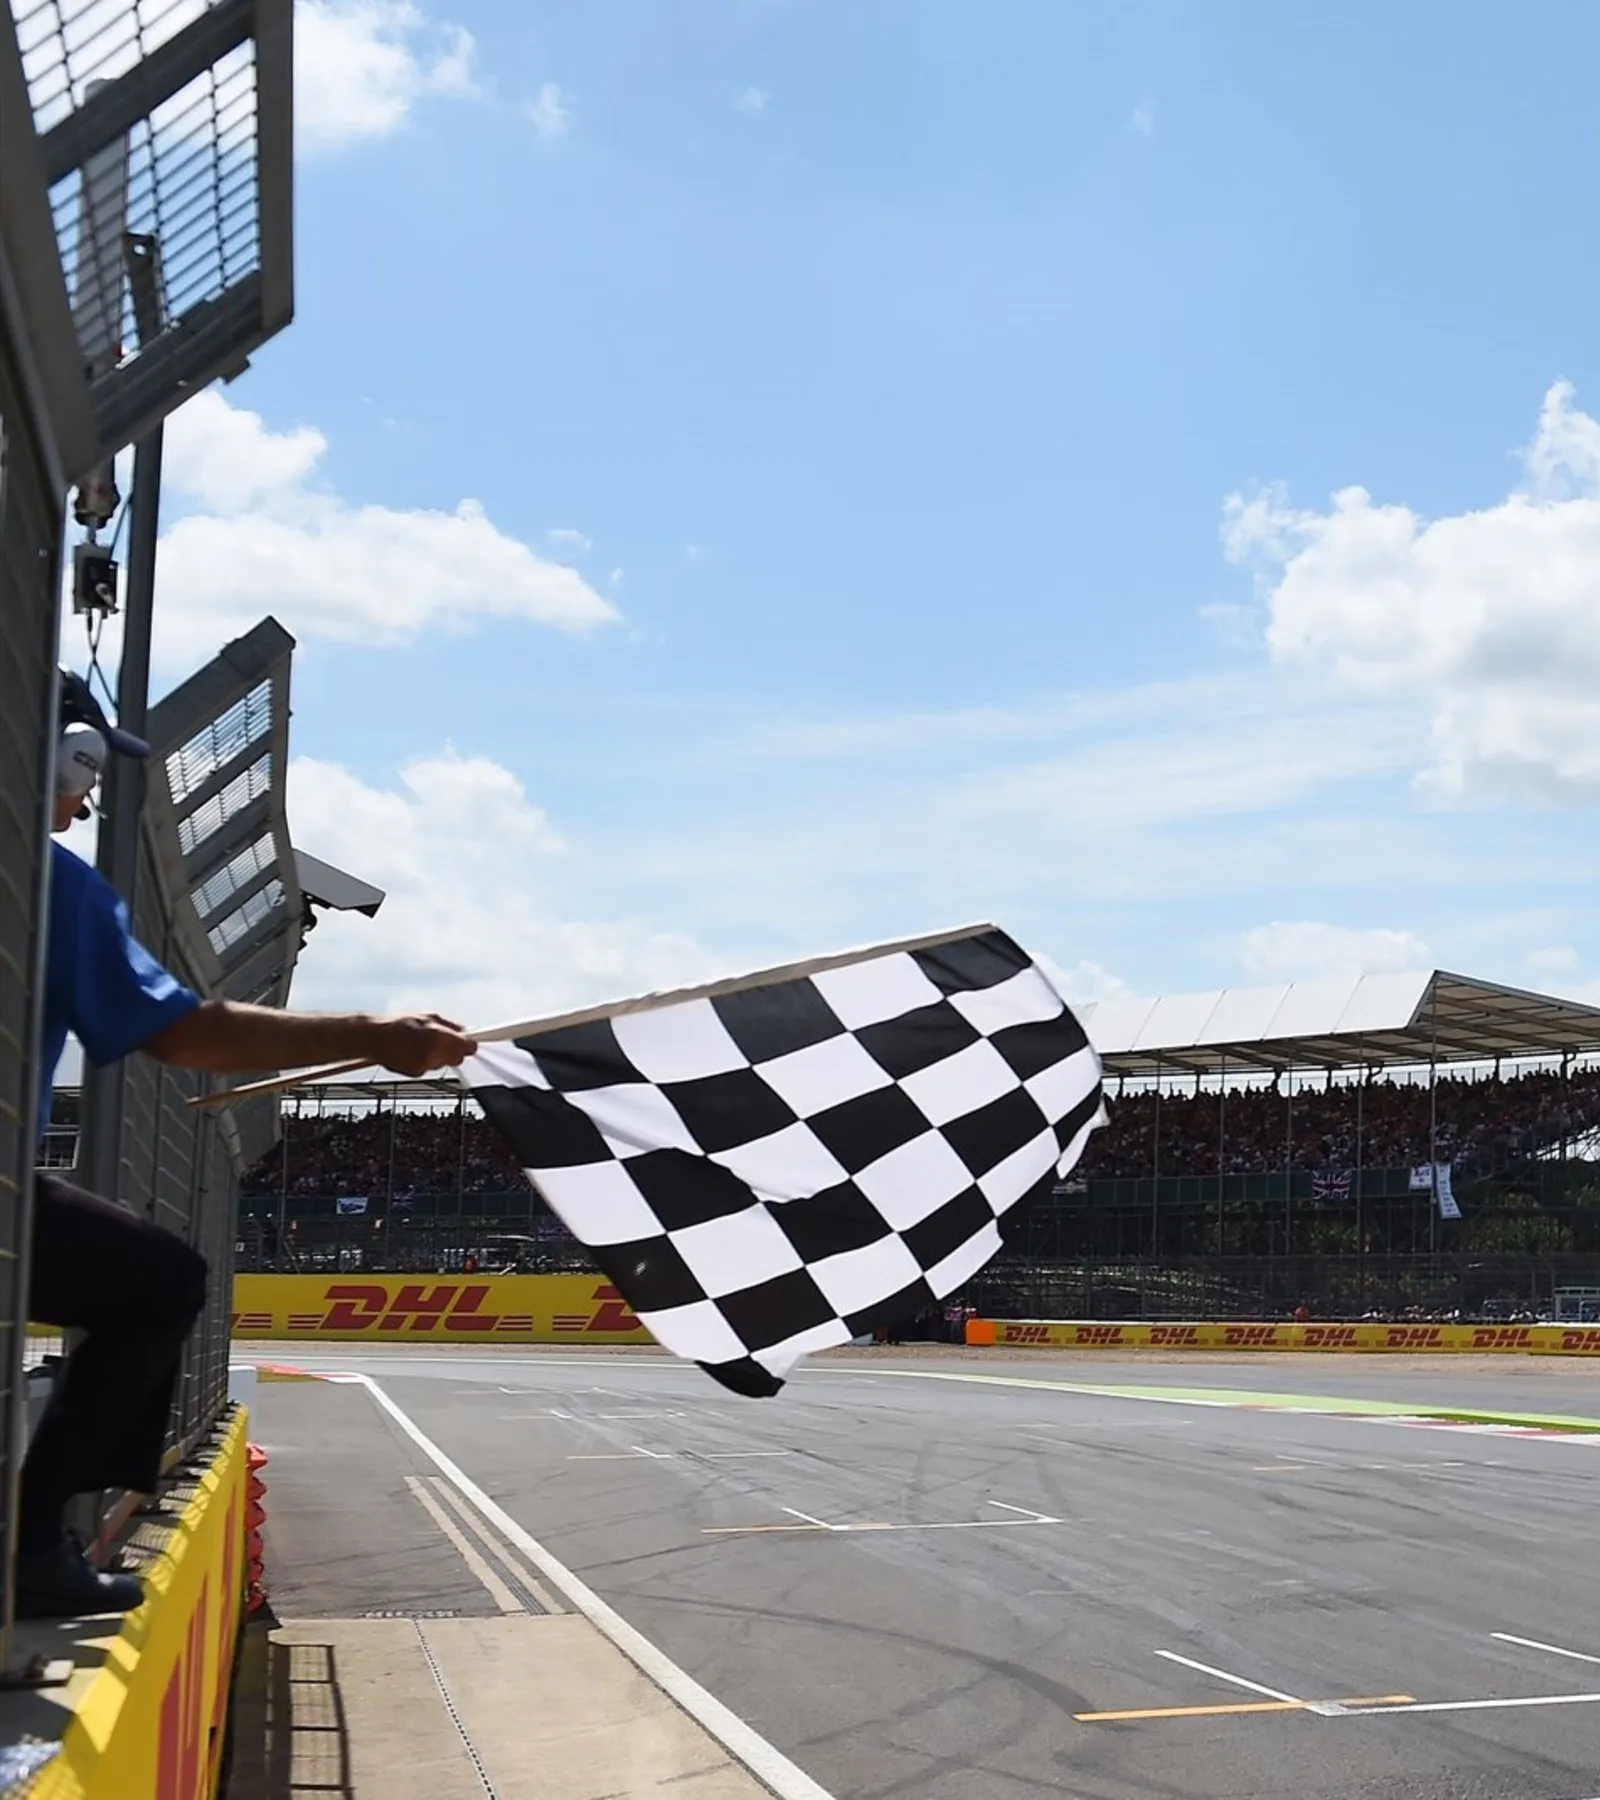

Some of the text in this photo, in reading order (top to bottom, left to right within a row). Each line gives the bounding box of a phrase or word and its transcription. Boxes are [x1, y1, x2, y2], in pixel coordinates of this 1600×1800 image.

[319, 1285, 500, 1331] DHL
[1005, 1326, 1050, 1343] DHL
[1075, 1326, 1124, 1344] DHL
[1150, 1327, 1198, 1345] DHL
[1224, 1328, 1277, 1346] DHL
[1303, 1328, 1357, 1347] DHL
[1387, 1328, 1442, 1347] DHL
[1472, 1329, 1532, 1348] DHL
